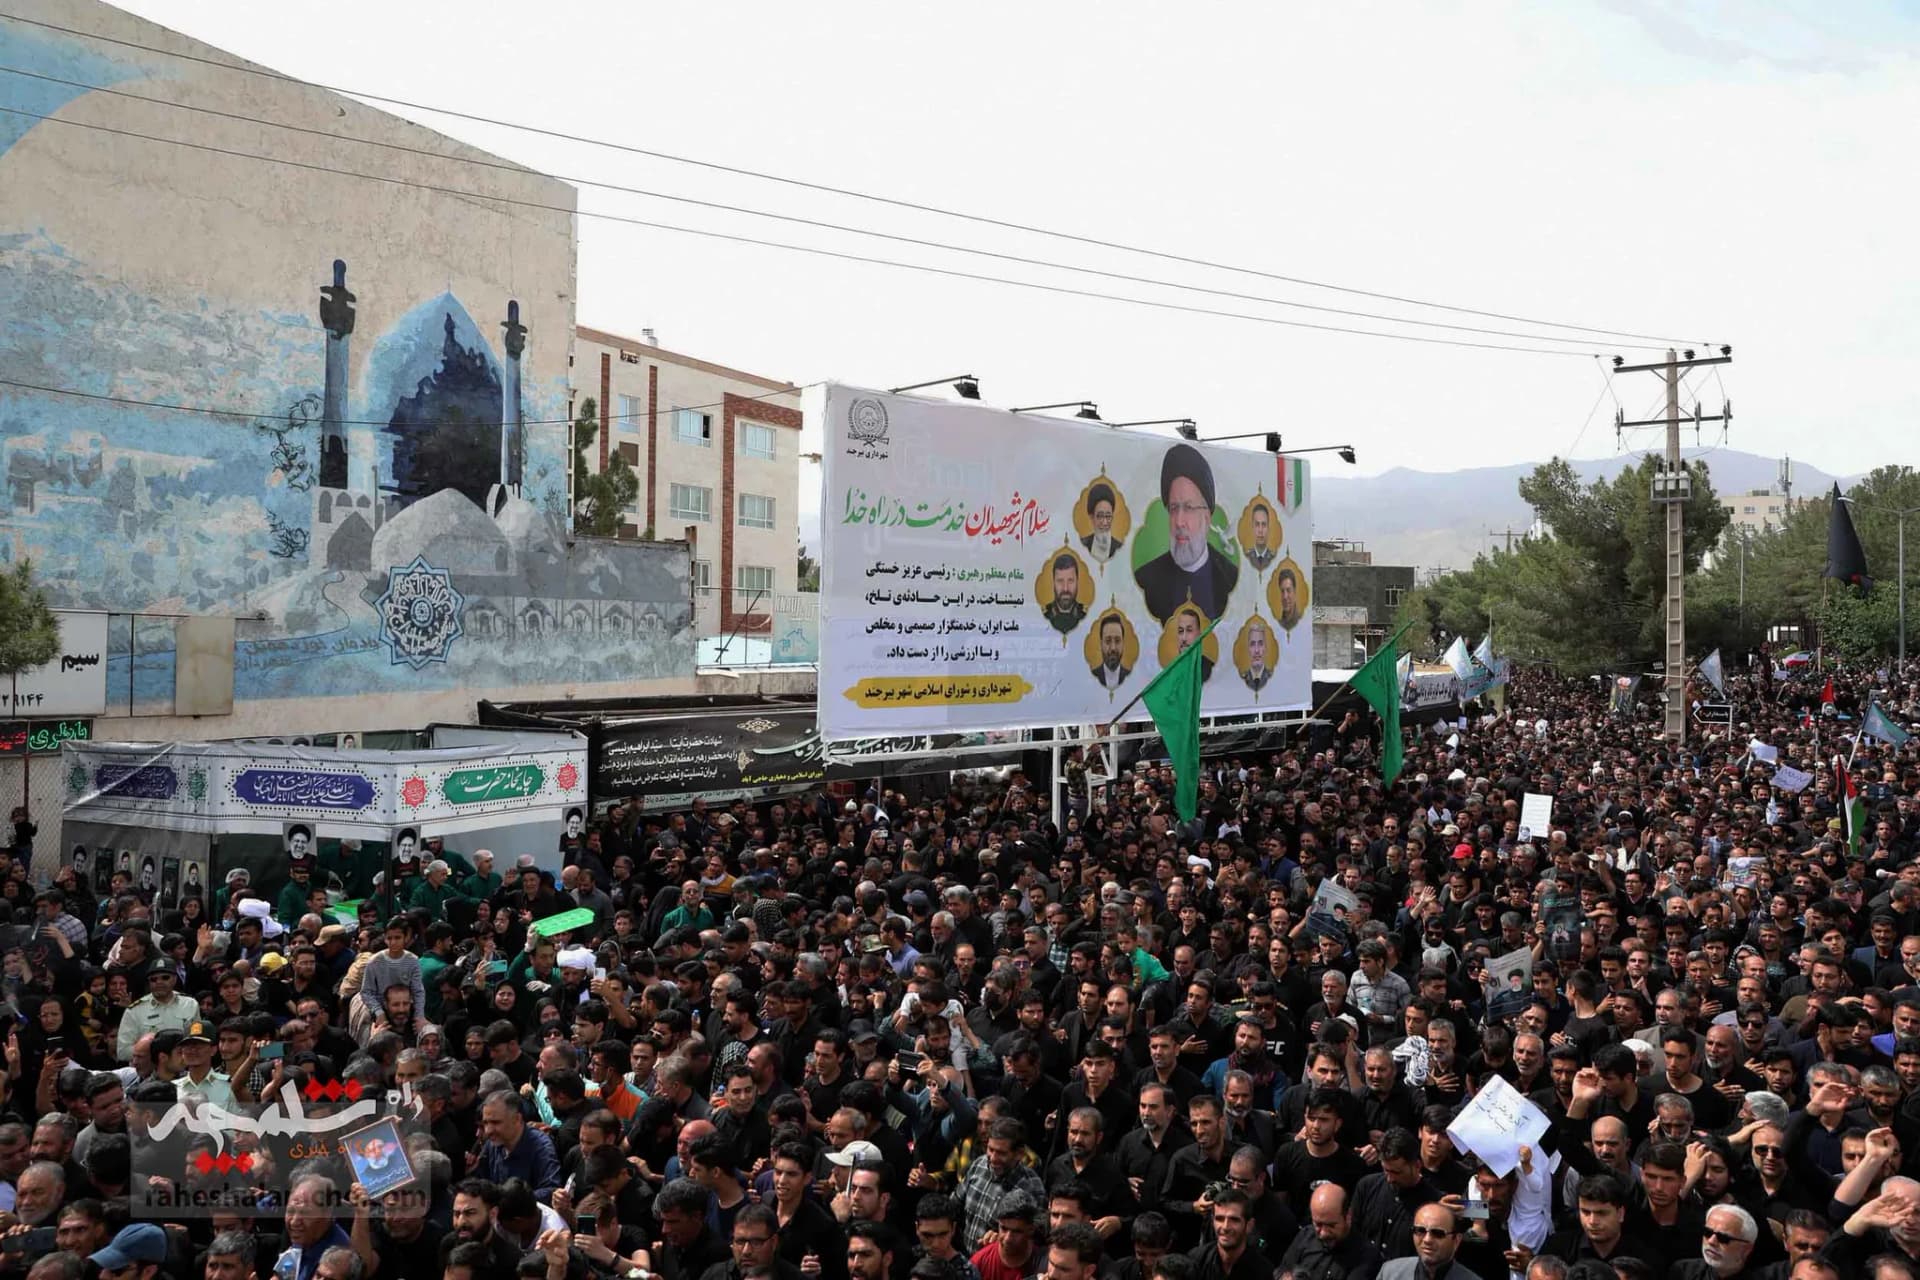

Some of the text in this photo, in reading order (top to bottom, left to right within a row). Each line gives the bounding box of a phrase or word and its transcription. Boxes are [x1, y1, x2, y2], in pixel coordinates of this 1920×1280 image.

[841, 487, 868, 524] خدا
[905, 501, 965, 532] خدمت
[866, 561, 900, 577] خستگی
[902, 564, 922, 579] عزیز
[923, 563, 951, 581] رئیسی
[985, 566, 1007, 582] معظم
[1007, 568, 1025, 582] مقام
[942, 592, 964, 607] این
[965, 594, 975, 608] در
[865, 617, 896, 634] مخلص
[897, 623, 903, 634] و
[904, 620, 936, 634] صمیمی
[937, 618, 977, 635] خدمتگزار
[1003, 620, 1019, 632] ملت
[907, 646, 929, 658] دست
[930, 645, 939, 661] از
[940, 645, 949, 661] را
[950, 645, 978, 661] ارزشی
[61, 653, 99, 672] سیم
[864, 681, 1012, 700] شهرداری و شورای اسلامی شهر بیرجند
[0, 693, 44, 707] ۲۹۱۴۴
[464, 768, 507, 799] حضرت
[503, 767, 533, 796] چایخانه
